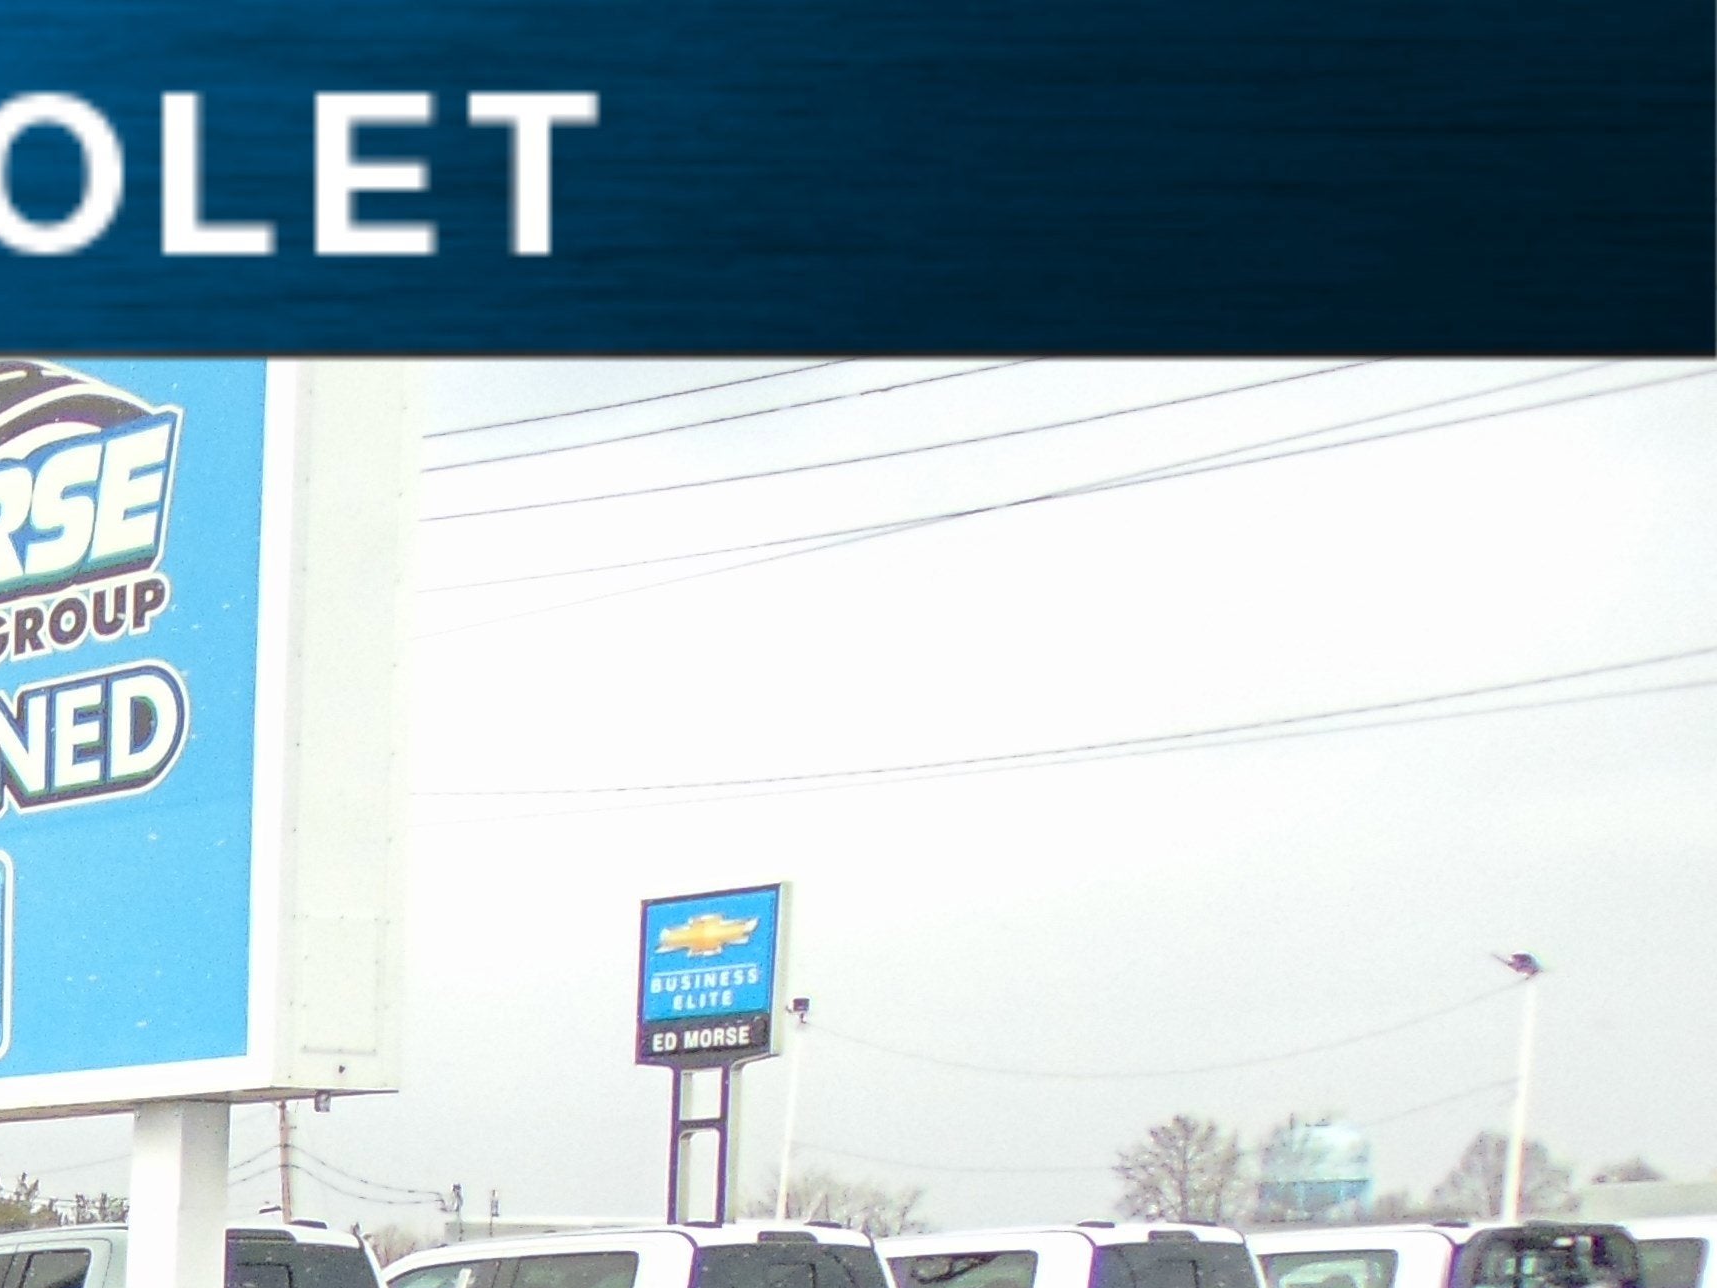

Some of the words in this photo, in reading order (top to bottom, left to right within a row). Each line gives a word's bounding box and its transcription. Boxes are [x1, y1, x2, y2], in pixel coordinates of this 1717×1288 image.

[651, 969, 758, 994] BUSINESS
[673, 991, 733, 1010] ELITE
[652, 1032, 677, 1052] ED
[683, 1026, 751, 1050] MORSE
